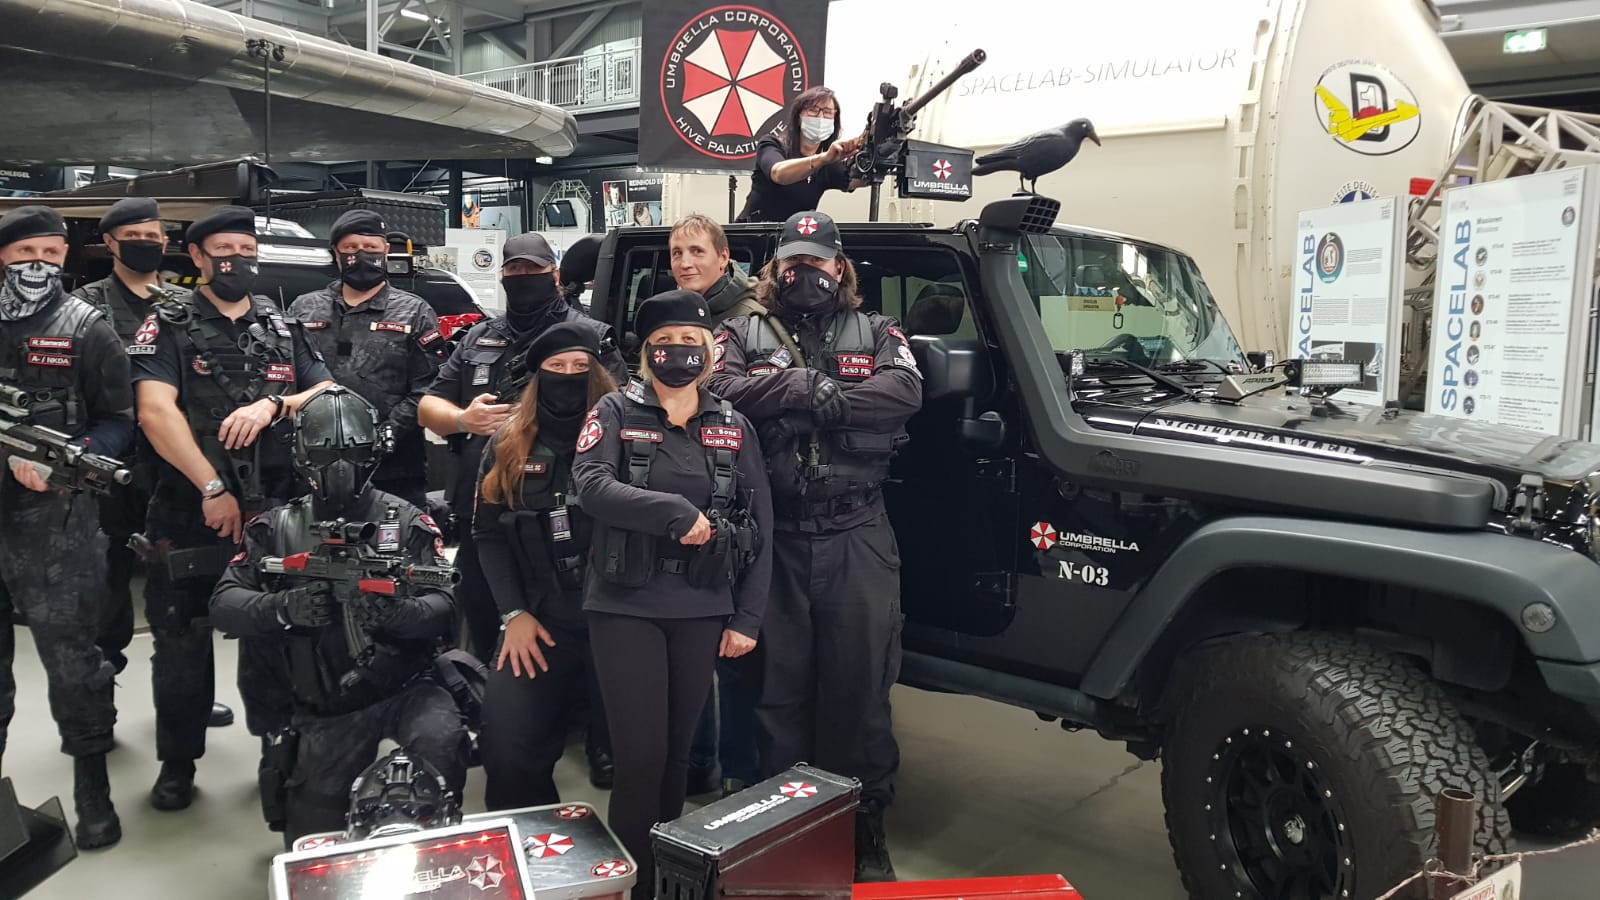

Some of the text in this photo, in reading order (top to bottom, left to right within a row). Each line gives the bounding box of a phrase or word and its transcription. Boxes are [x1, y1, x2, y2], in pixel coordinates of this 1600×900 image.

[666, 15, 719, 89] UMBRELLA
[724, 11, 802, 92] CORPORATION
[959, 48, 1237, 97] SPACELAB-SIMULATOR
[676, 116, 787, 155] HIVE PALATITE
[913, 180, 969, 191] UMBRELLA
[818, 277, 830, 289] FB
[1298, 233, 1316, 360] ACELAB
[1441, 219, 1471, 411] SPACELAB
[686, 356, 699, 365] AS
[1154, 418, 1357, 456] NIGHTCRAWLER
[1060, 531, 1140, 552] UMBRELLA
[1060, 540, 1117, 554] CORPORATION
[1058, 560, 1109, 586] N-03
[703, 795, 785, 830] UMBRELLA
